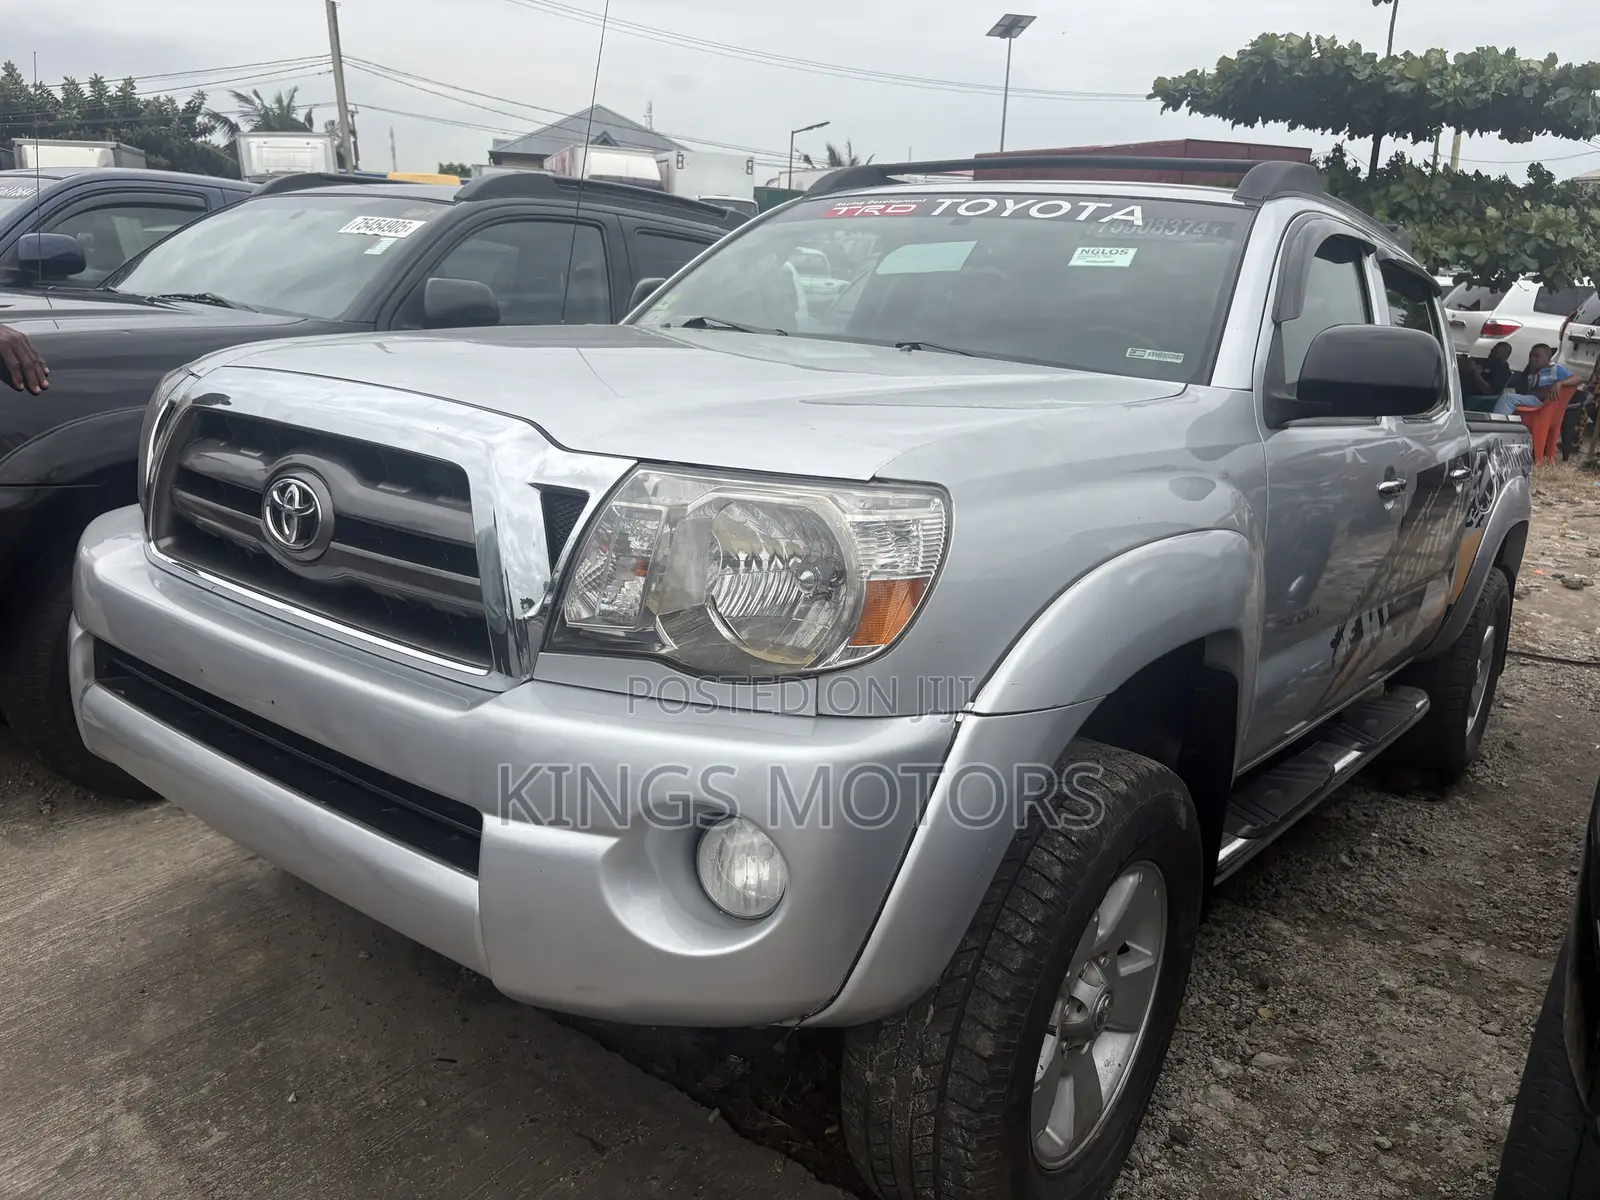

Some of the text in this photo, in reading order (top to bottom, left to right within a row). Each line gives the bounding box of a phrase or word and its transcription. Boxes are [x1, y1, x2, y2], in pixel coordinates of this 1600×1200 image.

[832, 204, 917, 216] TRD
[930, 198, 1143, 226] TOYOTA
[1079, 248, 1130, 256] NGLOS
